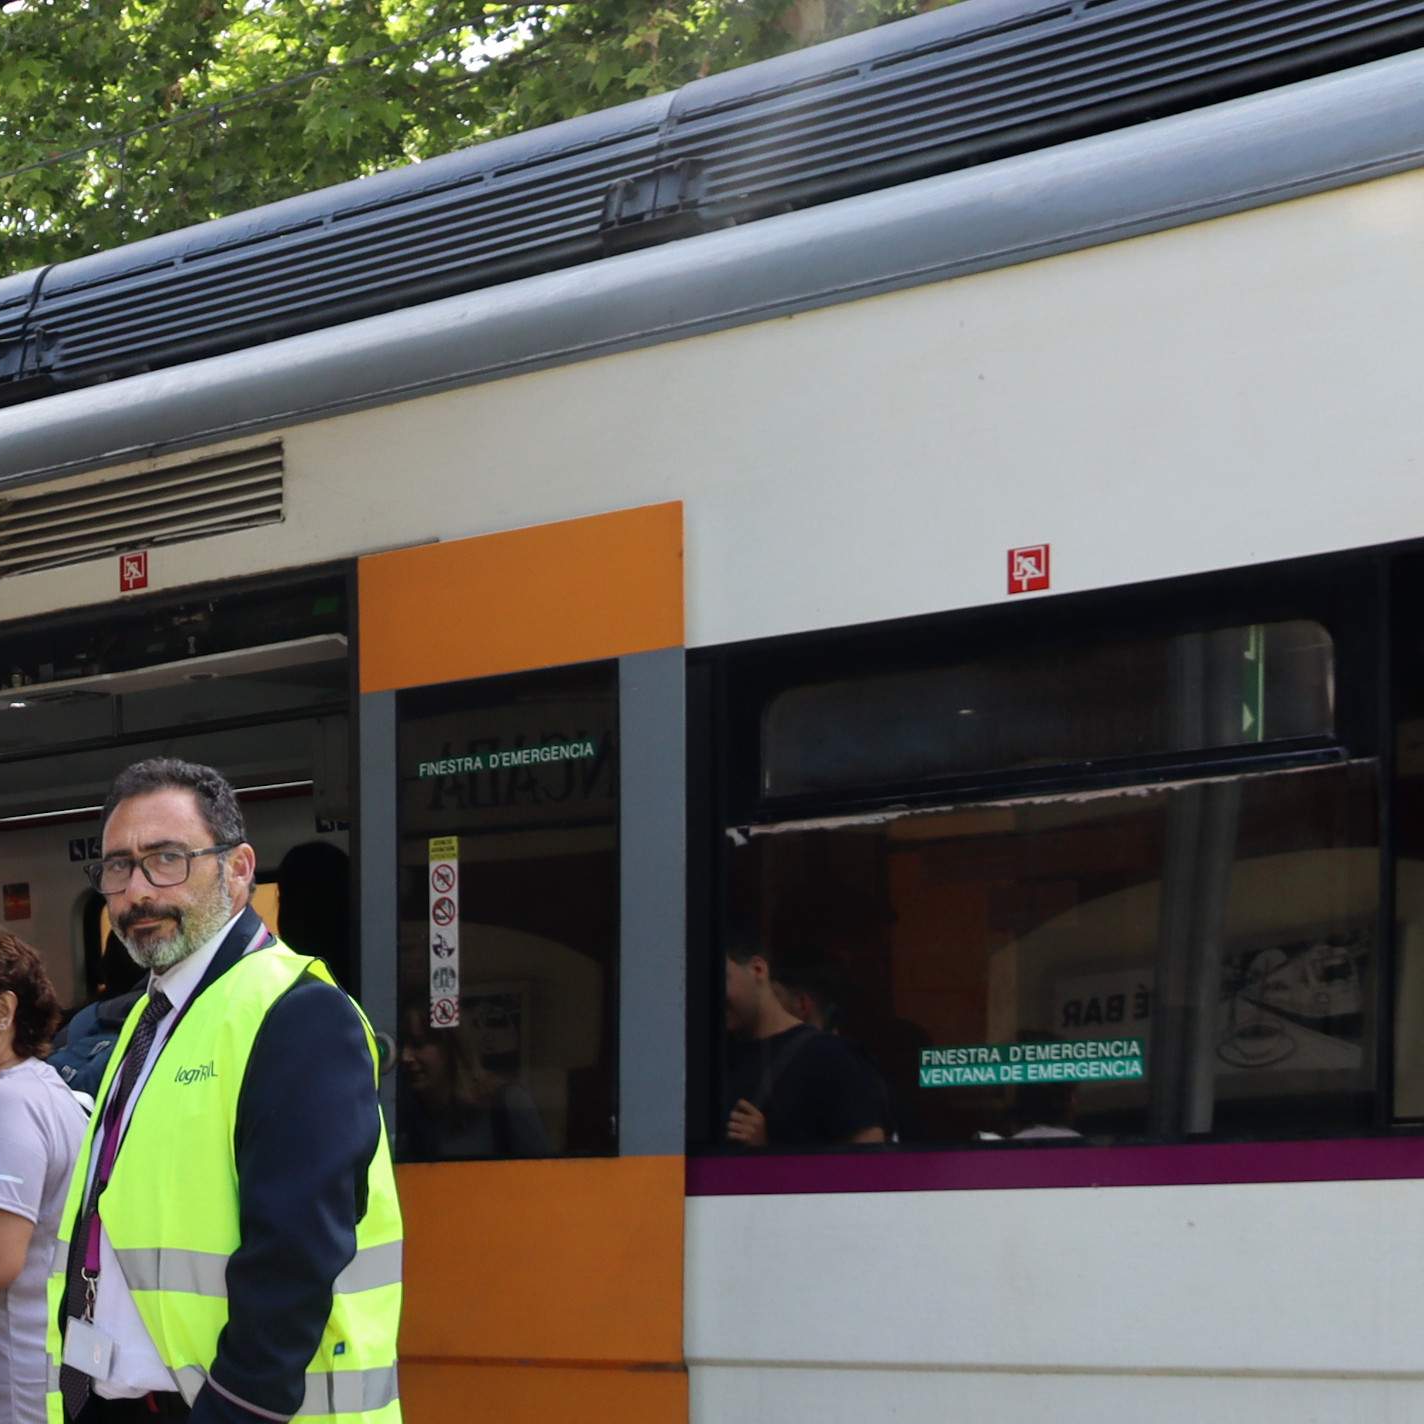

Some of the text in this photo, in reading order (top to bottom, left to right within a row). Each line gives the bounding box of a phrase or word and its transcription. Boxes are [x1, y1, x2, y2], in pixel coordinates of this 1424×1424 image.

[418, 756, 484, 777] FINESTRA
[921, 1047, 1001, 1066] FINESTRA
[920, 1060, 1143, 1085] VENTANA DE EMERGENCIA
